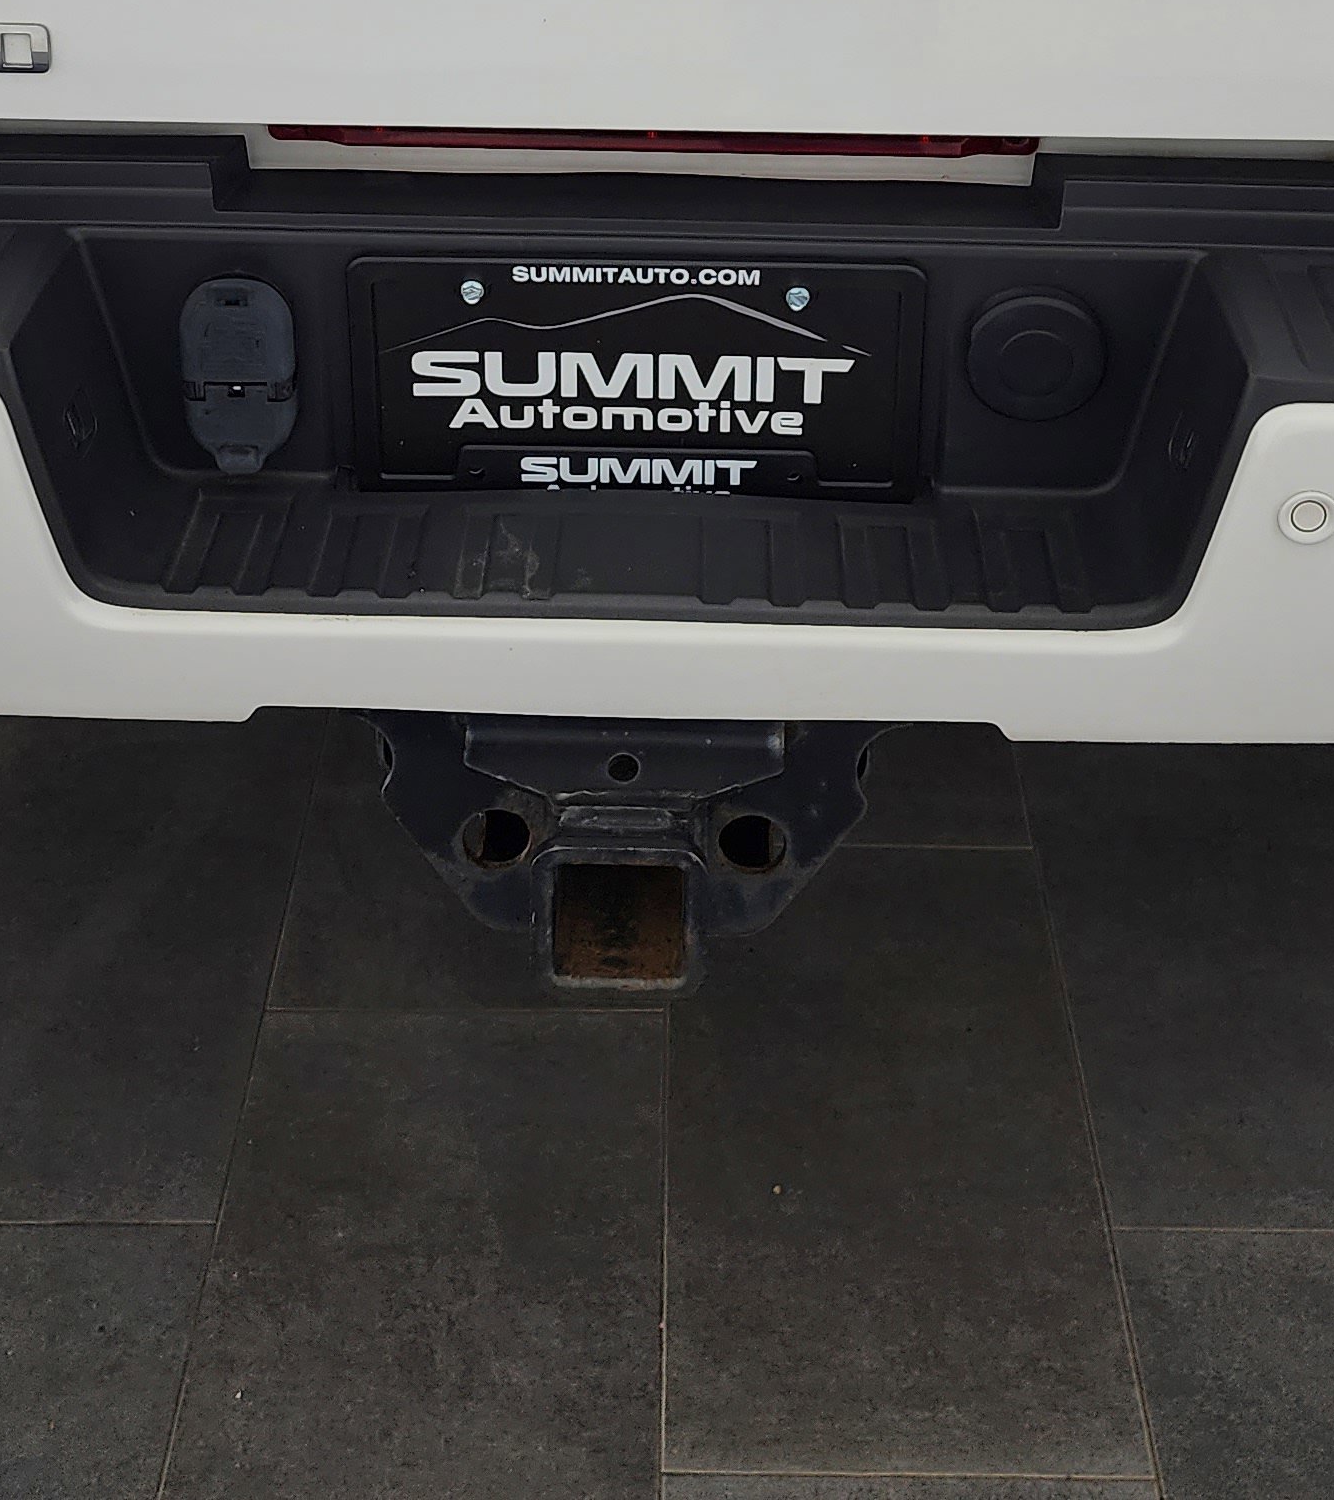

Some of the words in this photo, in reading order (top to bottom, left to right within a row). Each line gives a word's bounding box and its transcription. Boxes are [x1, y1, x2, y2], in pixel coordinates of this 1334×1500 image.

[512, 265, 761, 286] SUMMITAUTO.COM
[411, 351, 855, 404] SUMMIT
[449, 399, 804, 436] Automotive
[520, 456, 758, 486] SUMMIT
